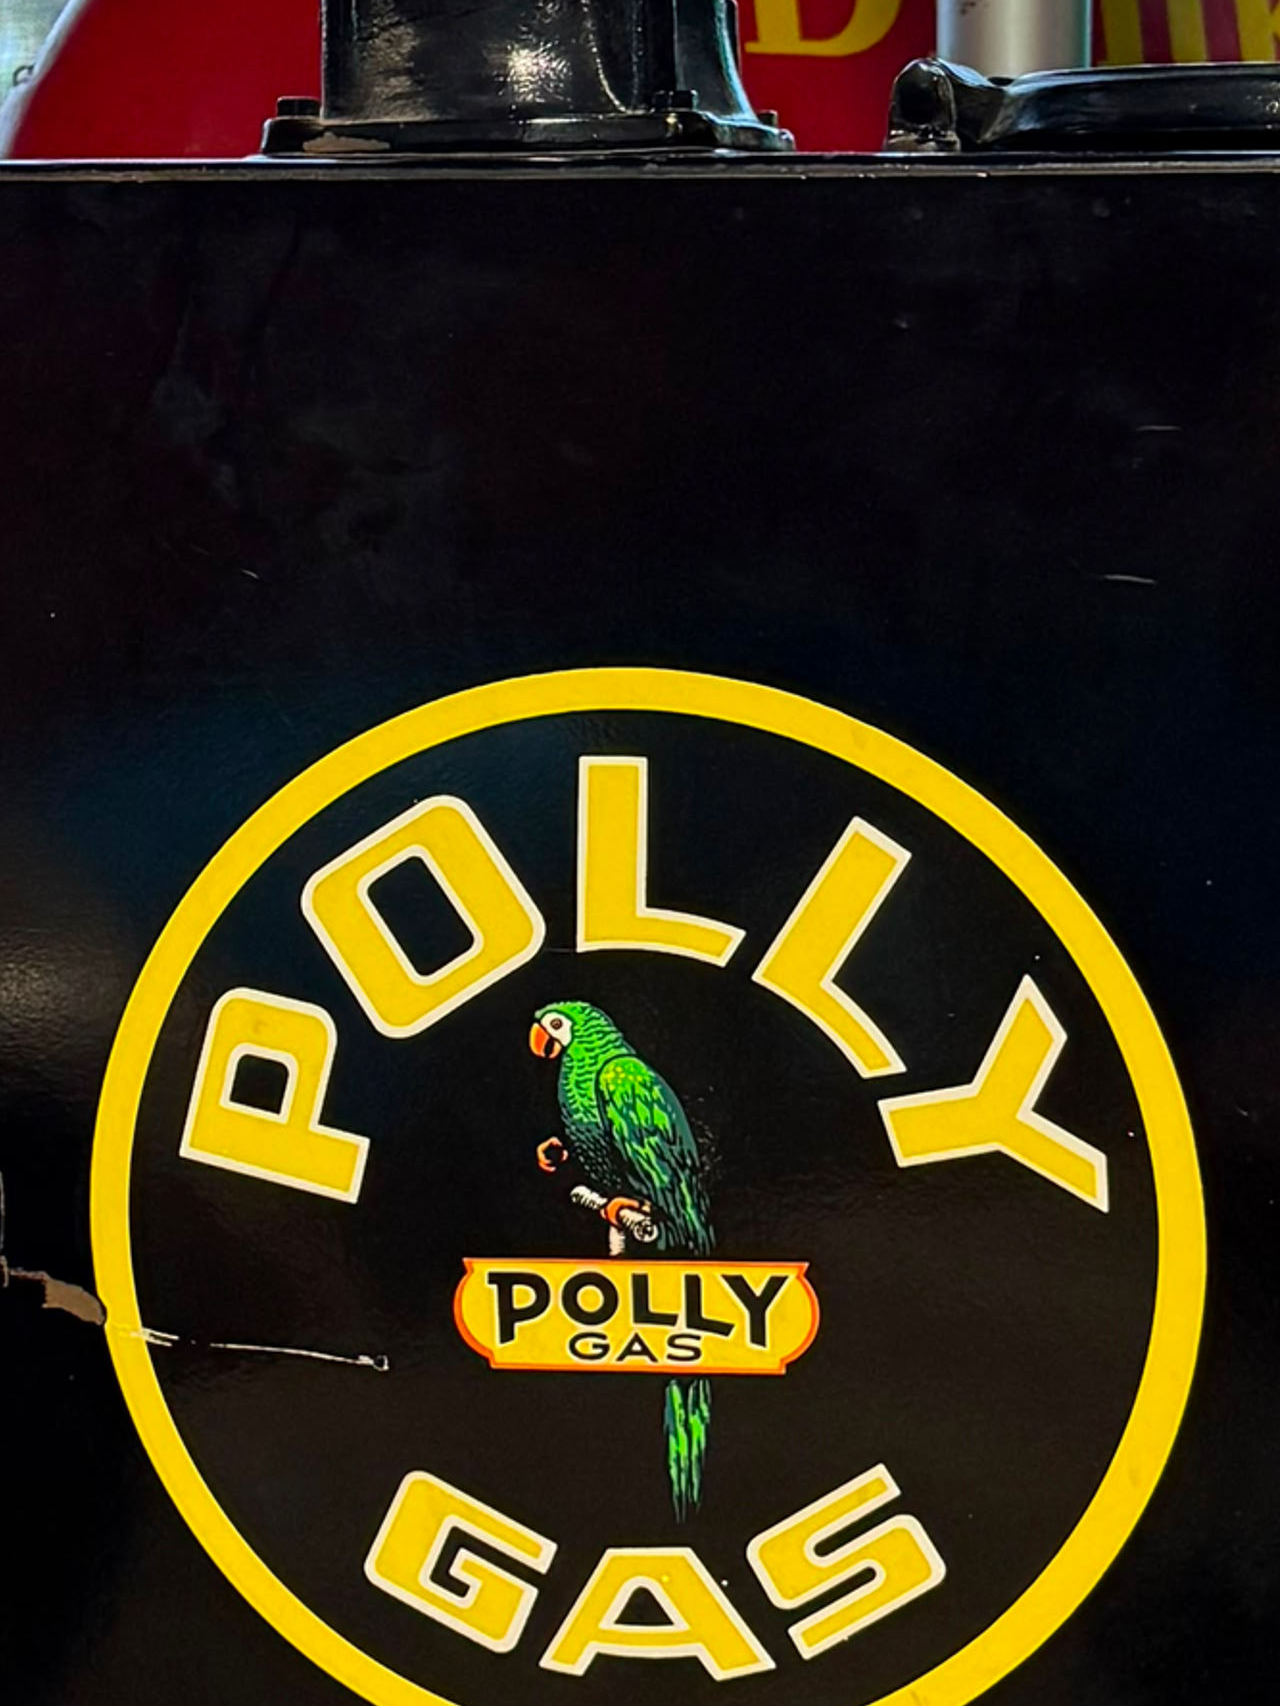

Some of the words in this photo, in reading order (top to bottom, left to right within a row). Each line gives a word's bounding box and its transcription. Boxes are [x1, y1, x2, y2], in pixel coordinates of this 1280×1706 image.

[179, 755, 1110, 1213] POLLY
[486, 1269, 791, 1350] POLLY
[567, 1331, 703, 1362] GAS
[364, 1463, 947, 1681] GAS
